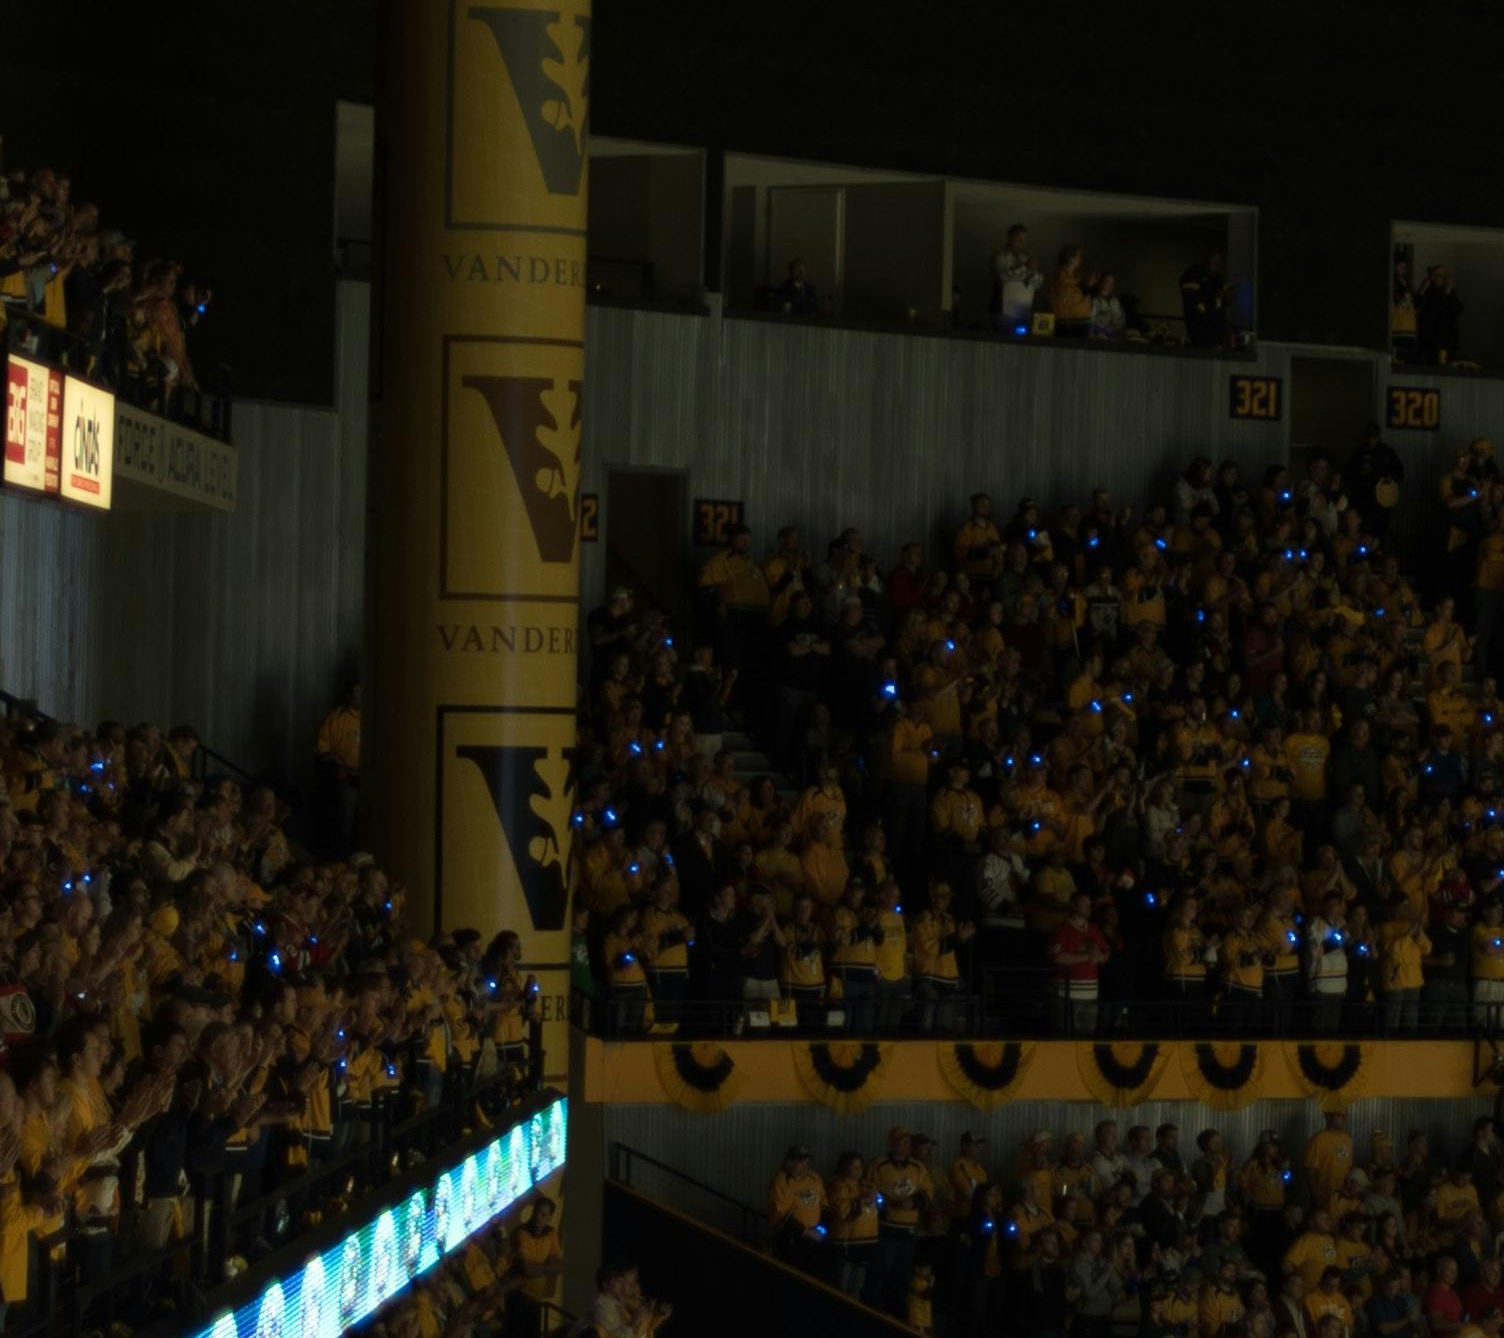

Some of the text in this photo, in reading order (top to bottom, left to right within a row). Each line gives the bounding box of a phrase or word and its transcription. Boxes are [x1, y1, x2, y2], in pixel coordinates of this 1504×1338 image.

[443, 253, 586, 288] VANDER
[1236, 380, 1278, 418] 321
[1394, 390, 1440, 428] 320
[437, 623, 577, 654] VANDER
